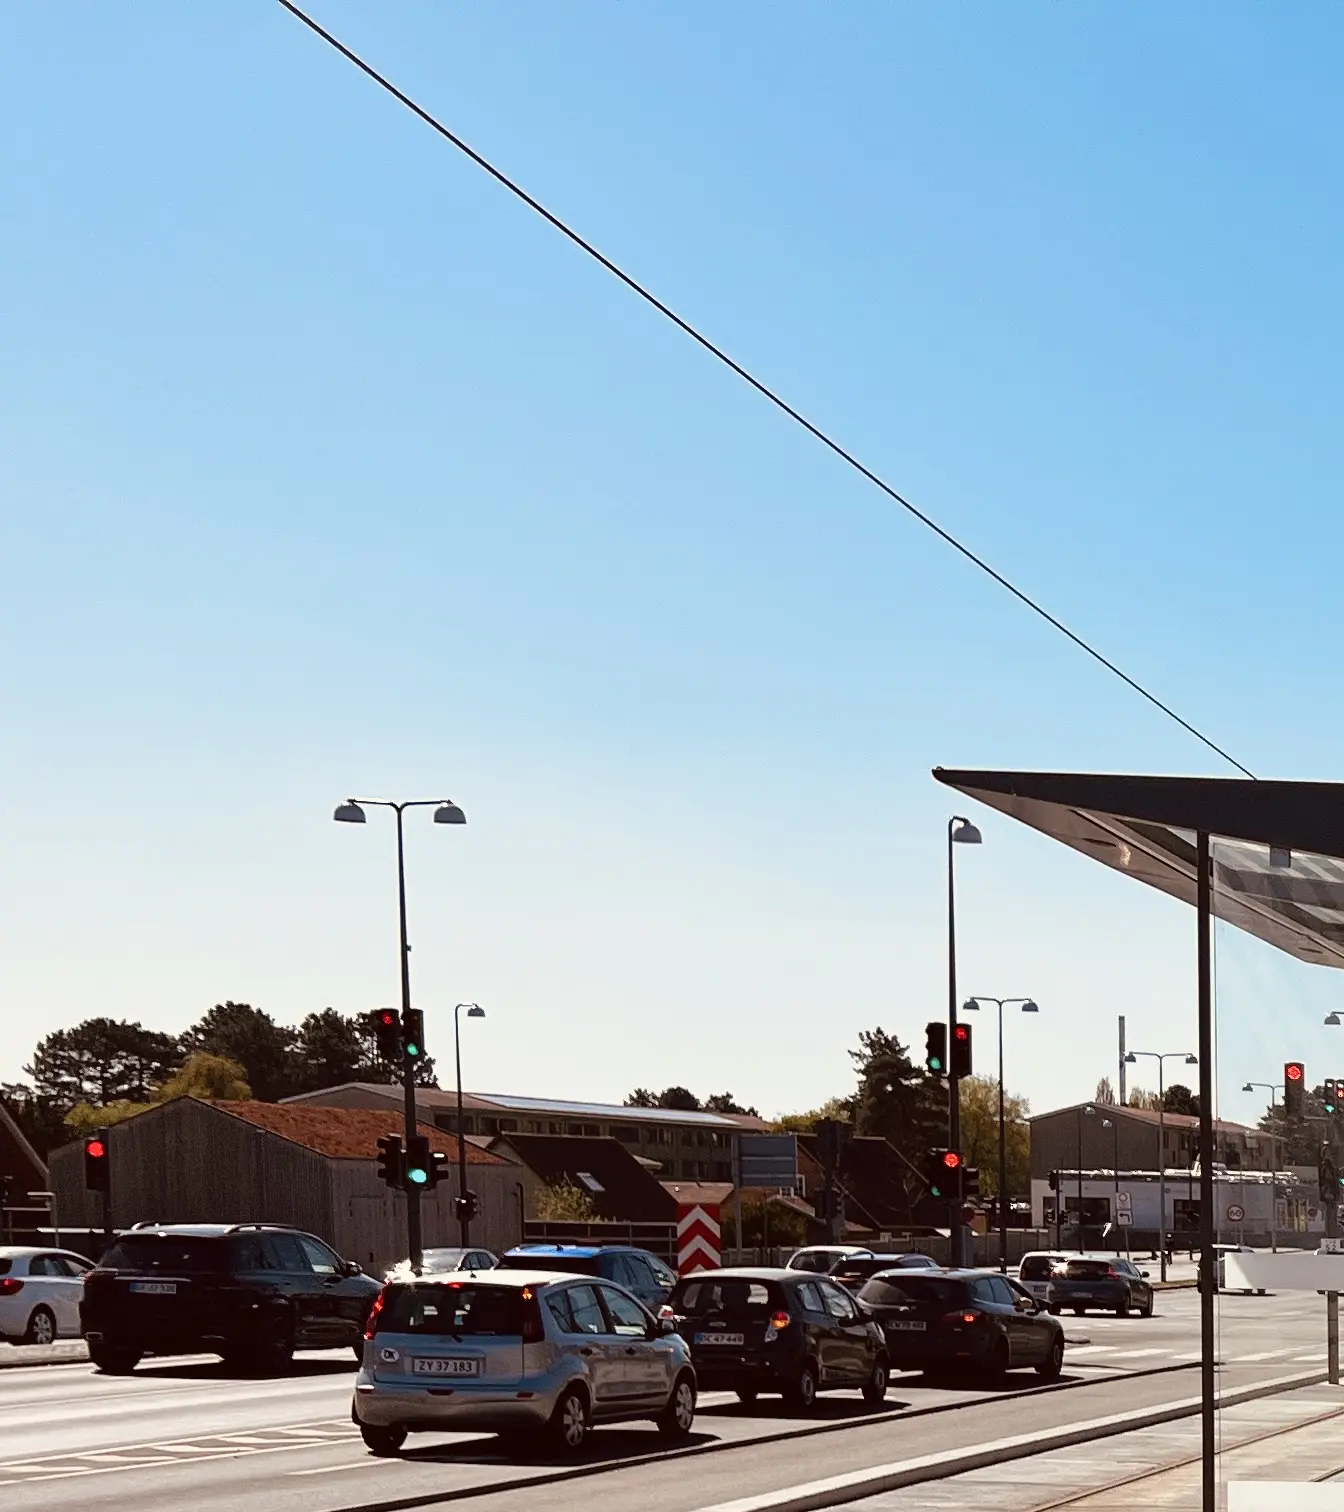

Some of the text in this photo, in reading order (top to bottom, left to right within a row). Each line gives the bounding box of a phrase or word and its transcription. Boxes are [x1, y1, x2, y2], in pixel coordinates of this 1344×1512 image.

[1229, 1209, 1241, 1218] 60
[418, 1360, 473, 1373] ZY 37 183
